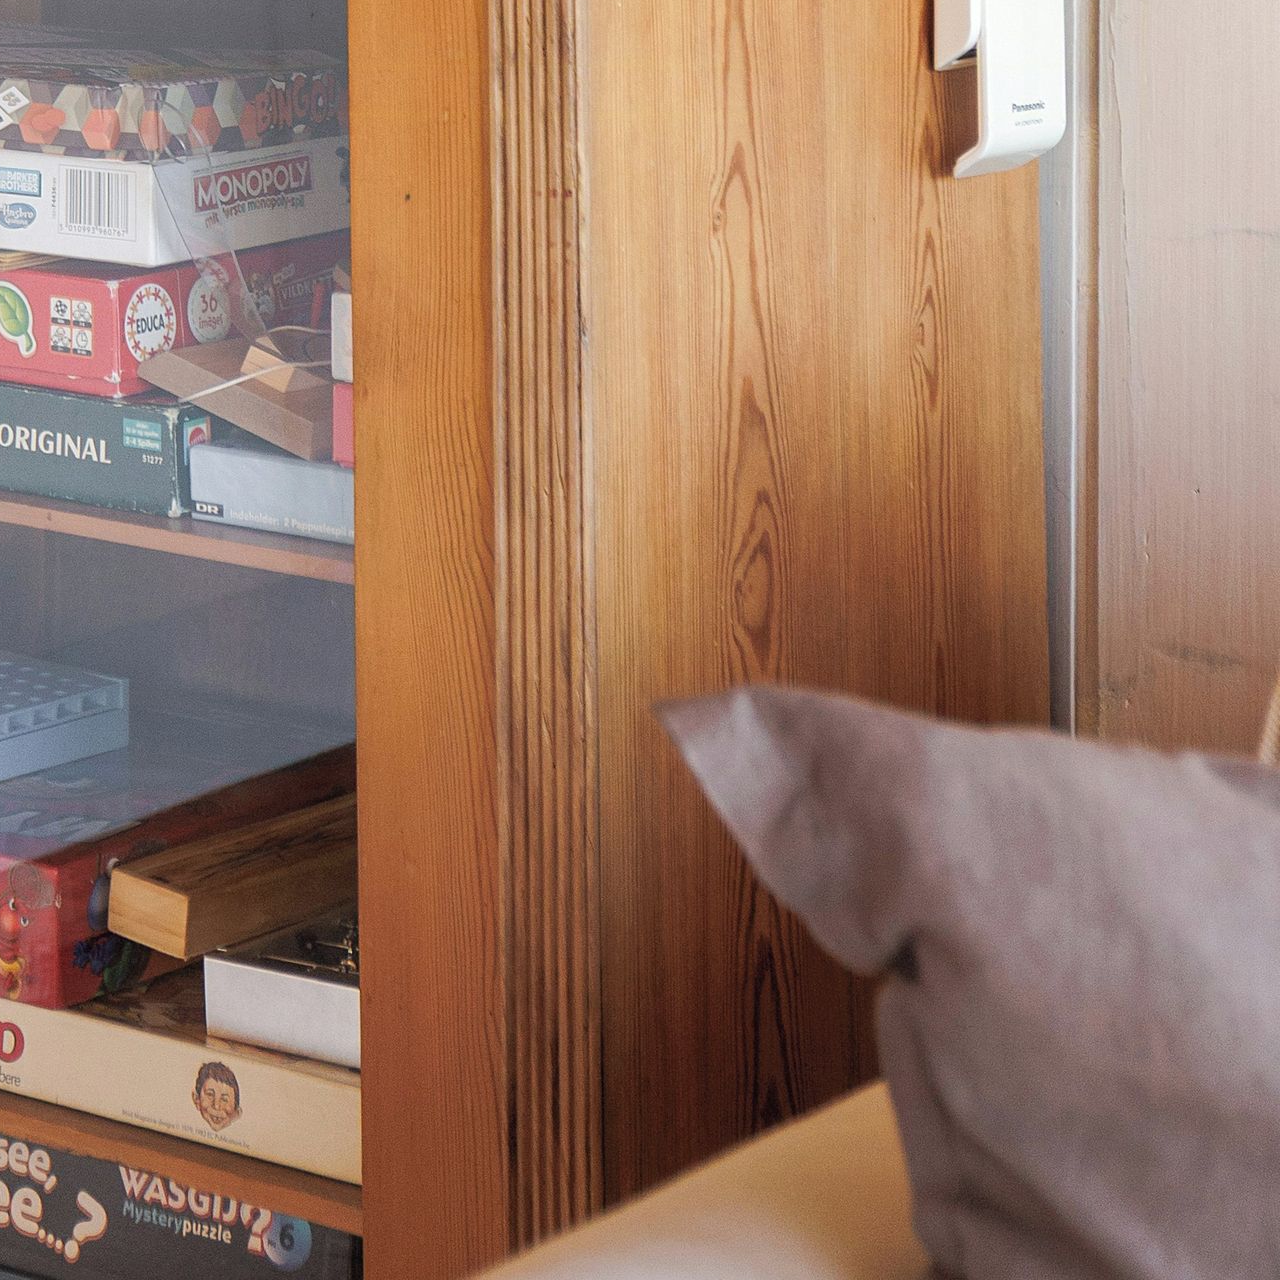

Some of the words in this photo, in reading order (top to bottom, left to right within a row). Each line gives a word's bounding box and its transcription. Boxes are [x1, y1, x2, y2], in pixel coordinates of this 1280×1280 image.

[1011, 100, 1046, 112] Panasonic
[7, 171, 38, 184] PARKER
[197, 160, 309, 210] MONOPOLY
[1, 203, 34, 220] Hasbro
[200, 294, 218, 313] 36
[136, 315, 165, 334] EDUCA
[199, 314, 224, 331] images
[195, 503, 219, 515] DR
[279, 1223, 296, 1251] 6
